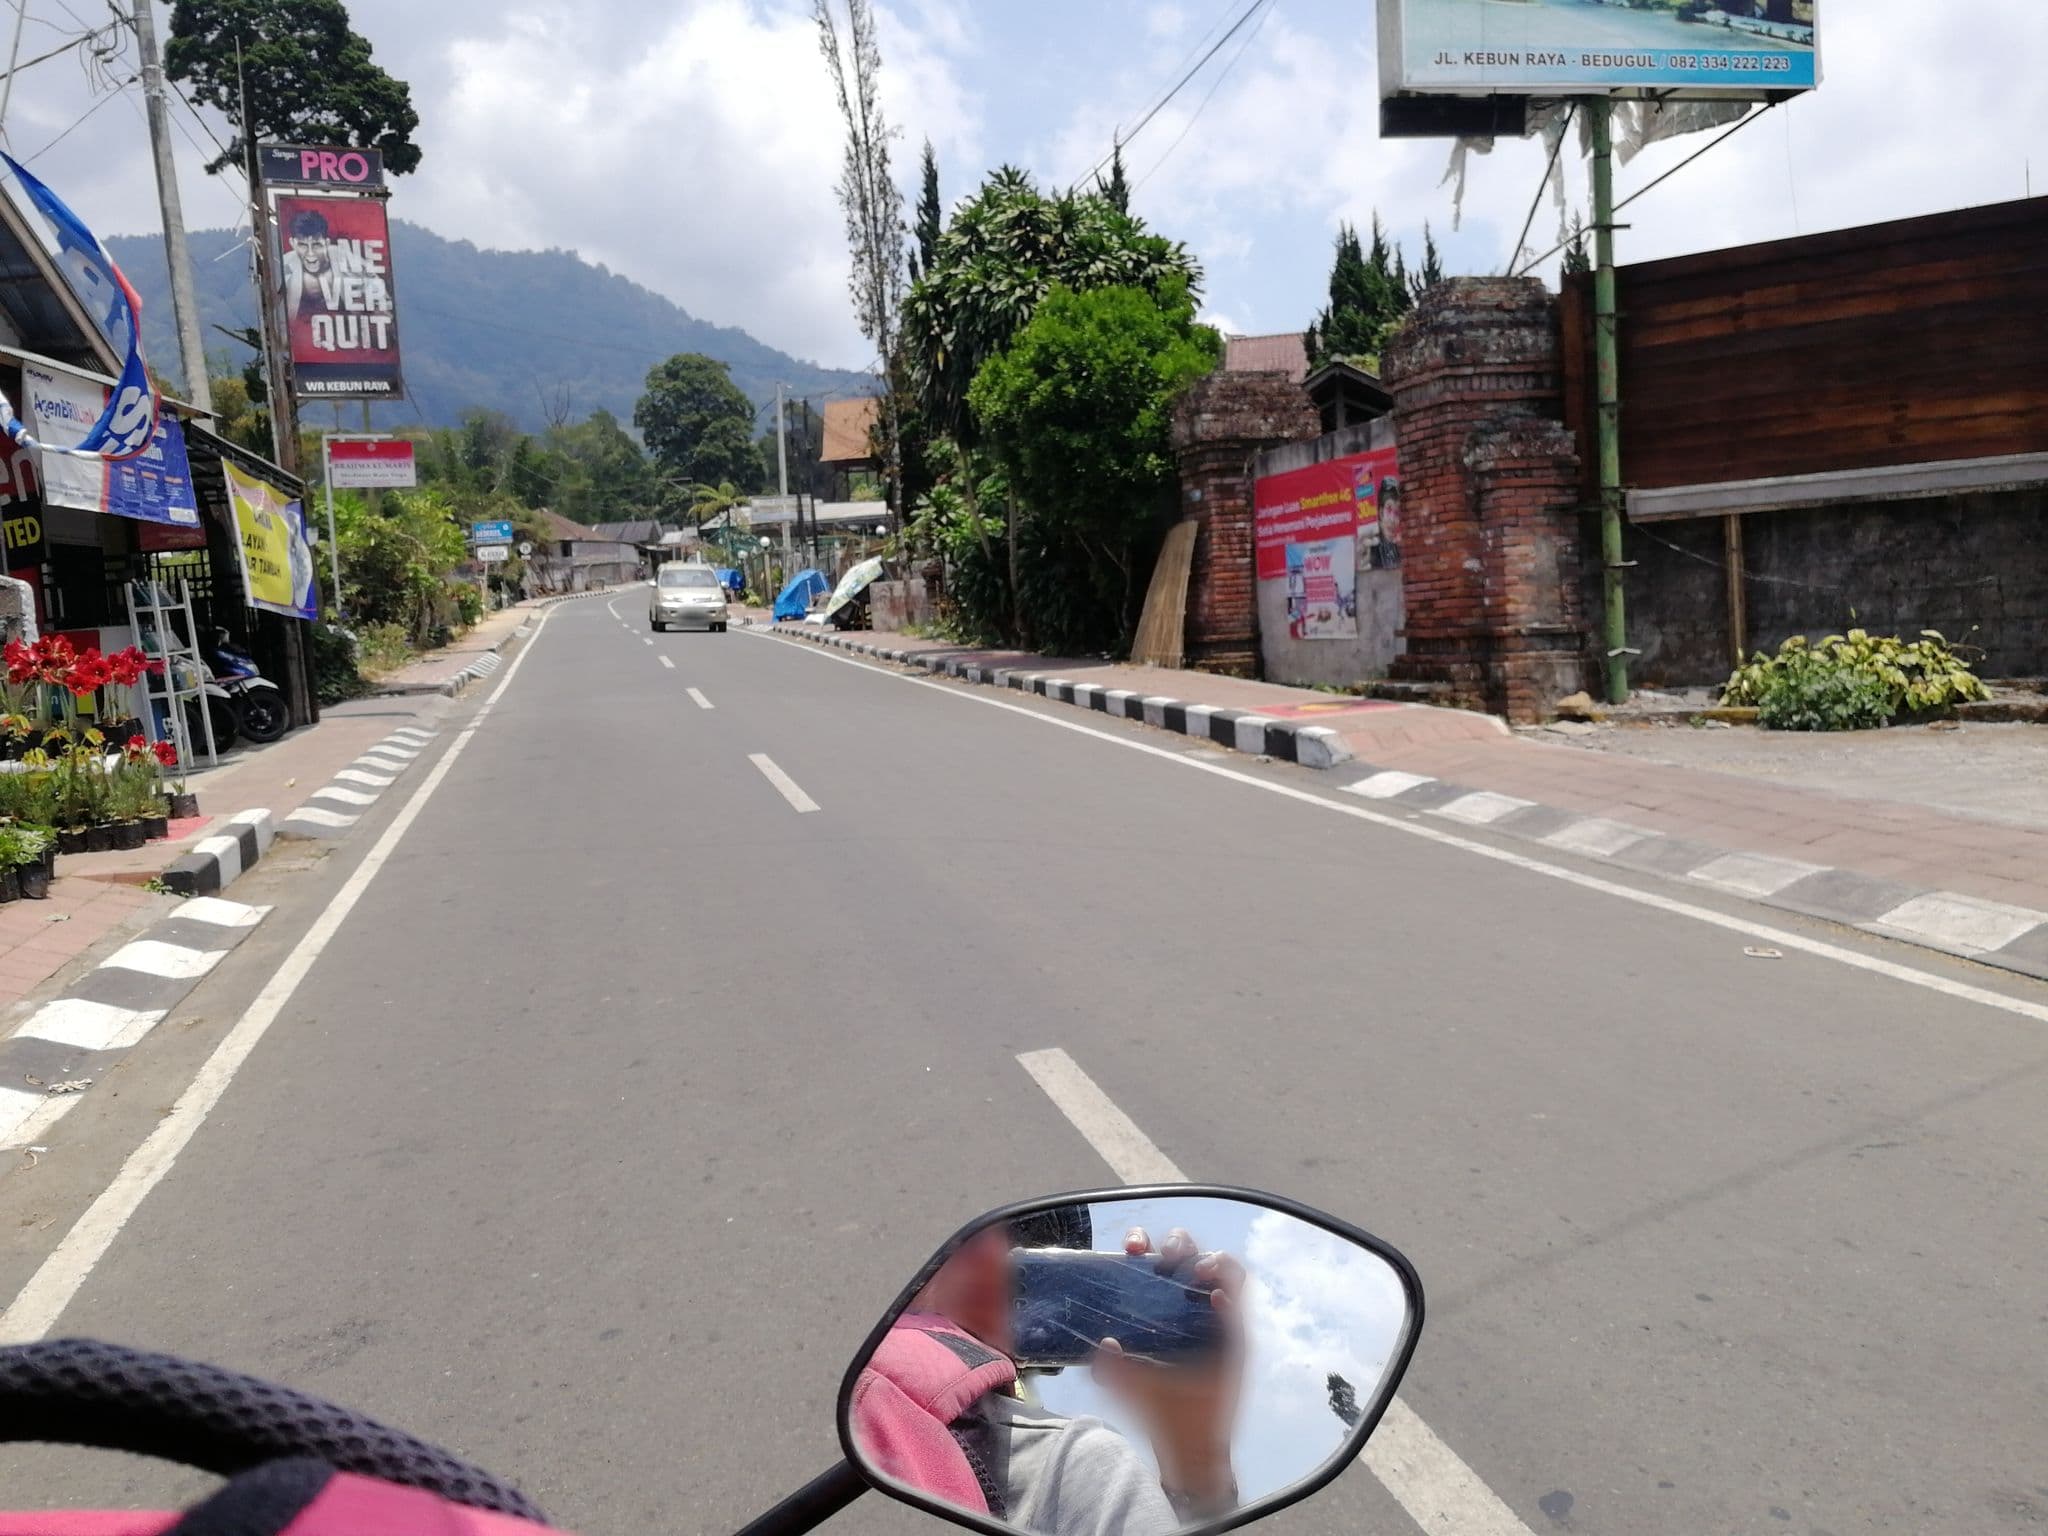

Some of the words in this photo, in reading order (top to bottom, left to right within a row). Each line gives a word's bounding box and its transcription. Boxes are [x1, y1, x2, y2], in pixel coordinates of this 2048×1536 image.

[1434, 52, 1458, 65] JL.
[1464, 52, 1520, 66] KEBUN
[1526, 53, 1567, 66] RAYA
[1581, 54, 1656, 68] BEDUGUL
[1669, 55, 1698, 69] 082
[1701, 55, 1729, 70] 334
[1732, 56, 1760, 71] 222
[1763, 57, 1790, 71] 223
[301, 150, 368, 182] PRO
[311, 314, 392, 351] QUIT
[306, 381, 325, 392] WR
[327, 381, 362, 393] KEBUN
[363, 382, 391, 392] RAYA
